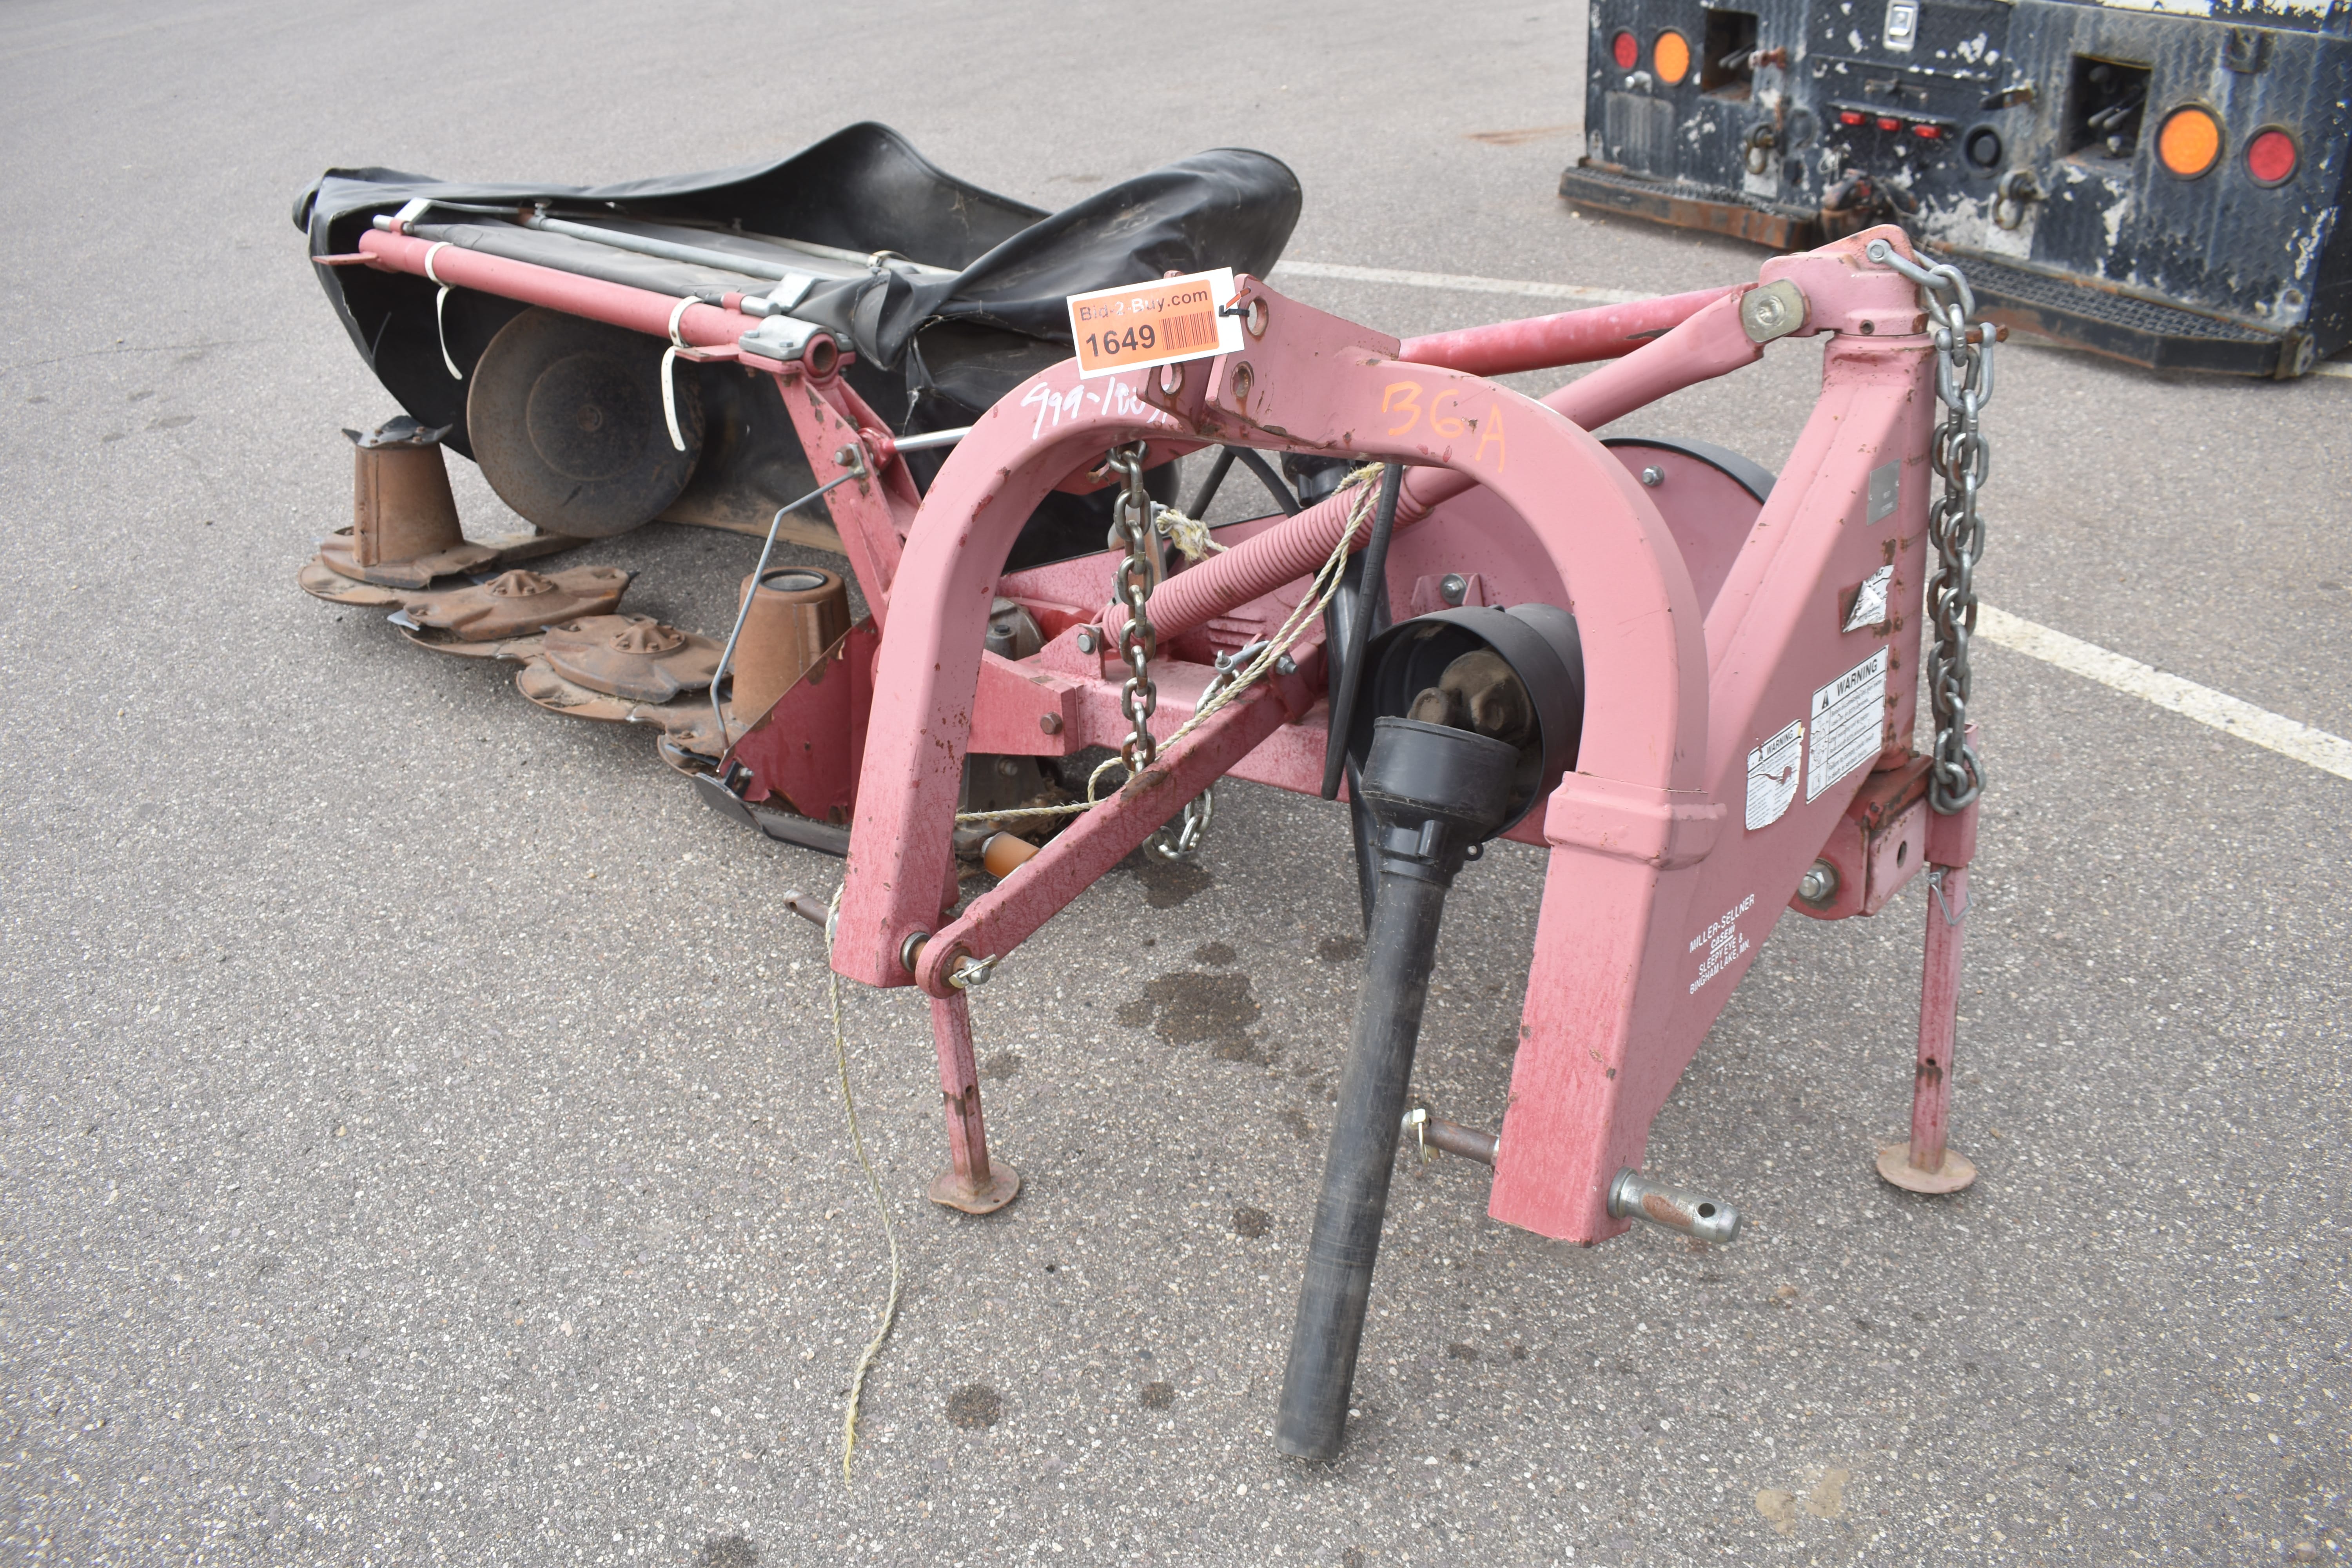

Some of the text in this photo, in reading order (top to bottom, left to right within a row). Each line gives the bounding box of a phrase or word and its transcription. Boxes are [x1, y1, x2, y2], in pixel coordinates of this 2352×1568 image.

[1080, 290, 1208, 321] Bid-2-Buy.com
[1086, 324, 1156, 357] 1649
[1837, 659, 1878, 696] WARNING
[1766, 730, 1793, 755] WARNING
[1690, 893, 1755, 953] MILLER-SELLNER
[1690, 939, 1750, 995] BINGHAM LAKE, MN.
[1699, 933, 1743, 975] SLEEPY EYE &
